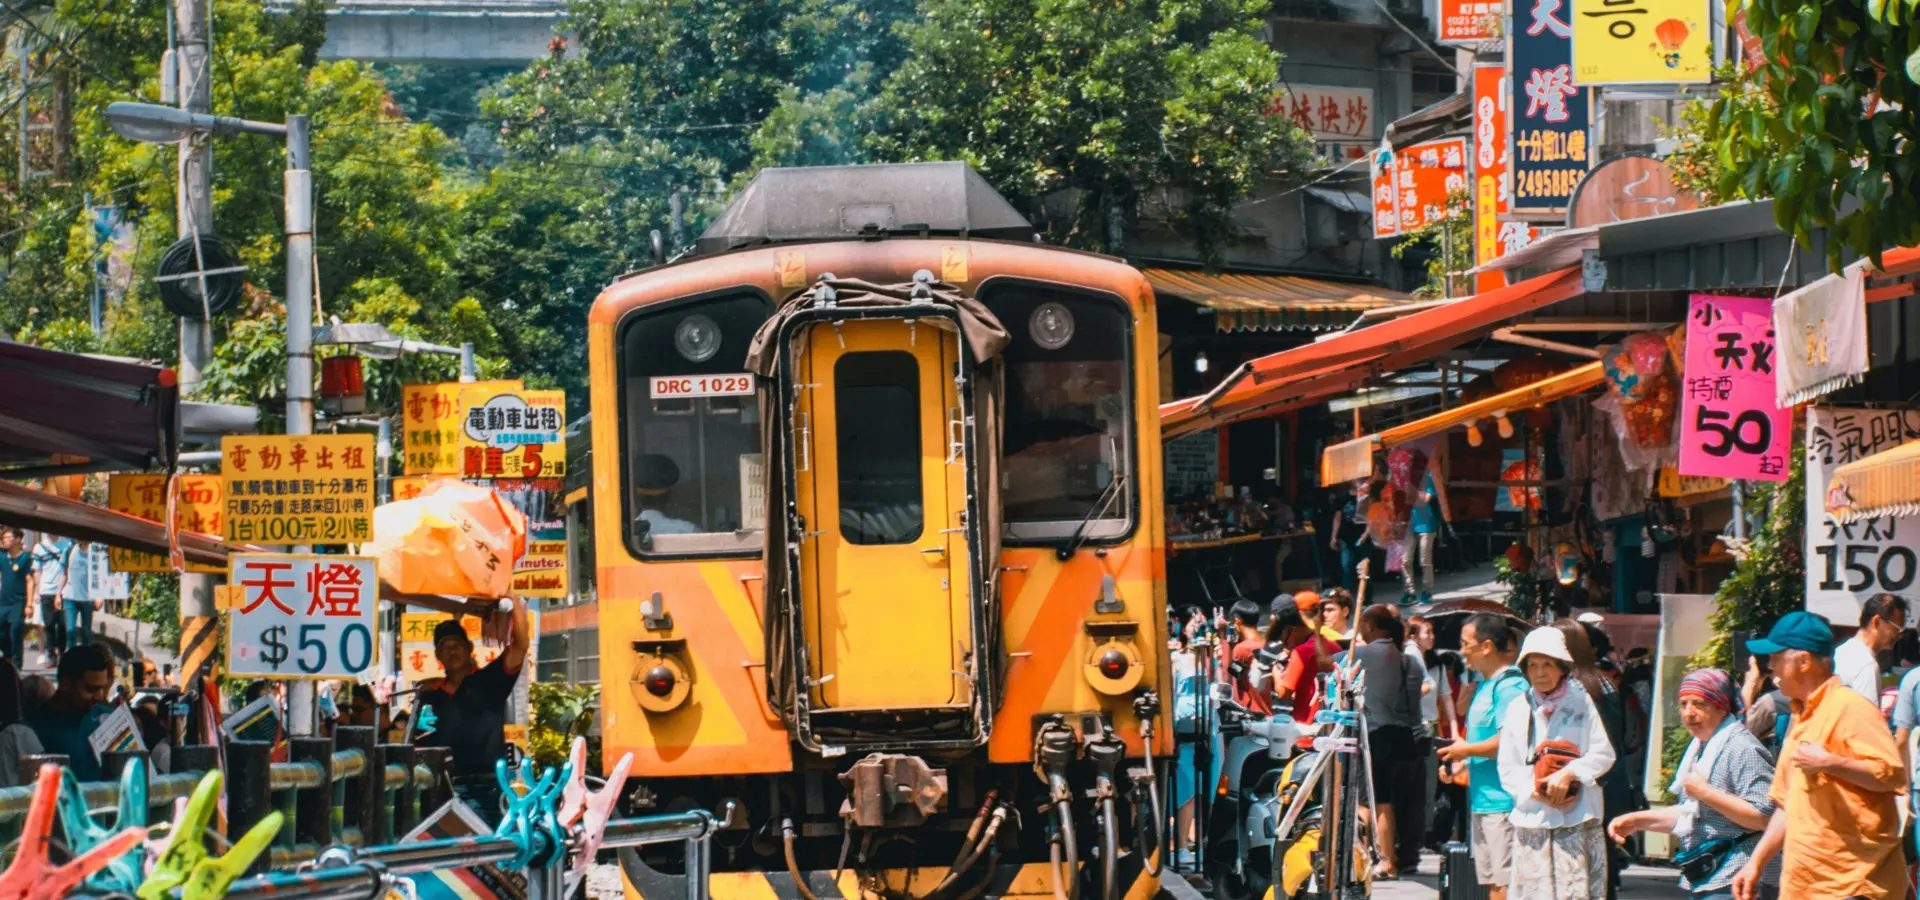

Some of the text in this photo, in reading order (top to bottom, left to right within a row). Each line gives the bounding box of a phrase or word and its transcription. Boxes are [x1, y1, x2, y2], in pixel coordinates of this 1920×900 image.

[1374, 165, 1394, 230] 肉麵
[1694, 303, 1722, 326] 小
[657, 378, 749, 394] DRC 1029
[407, 391, 460, 423] 電動
[469, 407, 557, 431] 電動車出租
[1696, 405, 1772, 457] 50
[229, 442, 366, 473] 電動車出租
[1760, 455, 1784, 475] 起
[229, 517, 369, 541] 1台(100元)2小時
[520, 558, 564, 569] inutes.
[1816, 544, 1917, 592] 150
[240, 562, 363, 617] 天燈
[260, 623, 373, 675] $50
